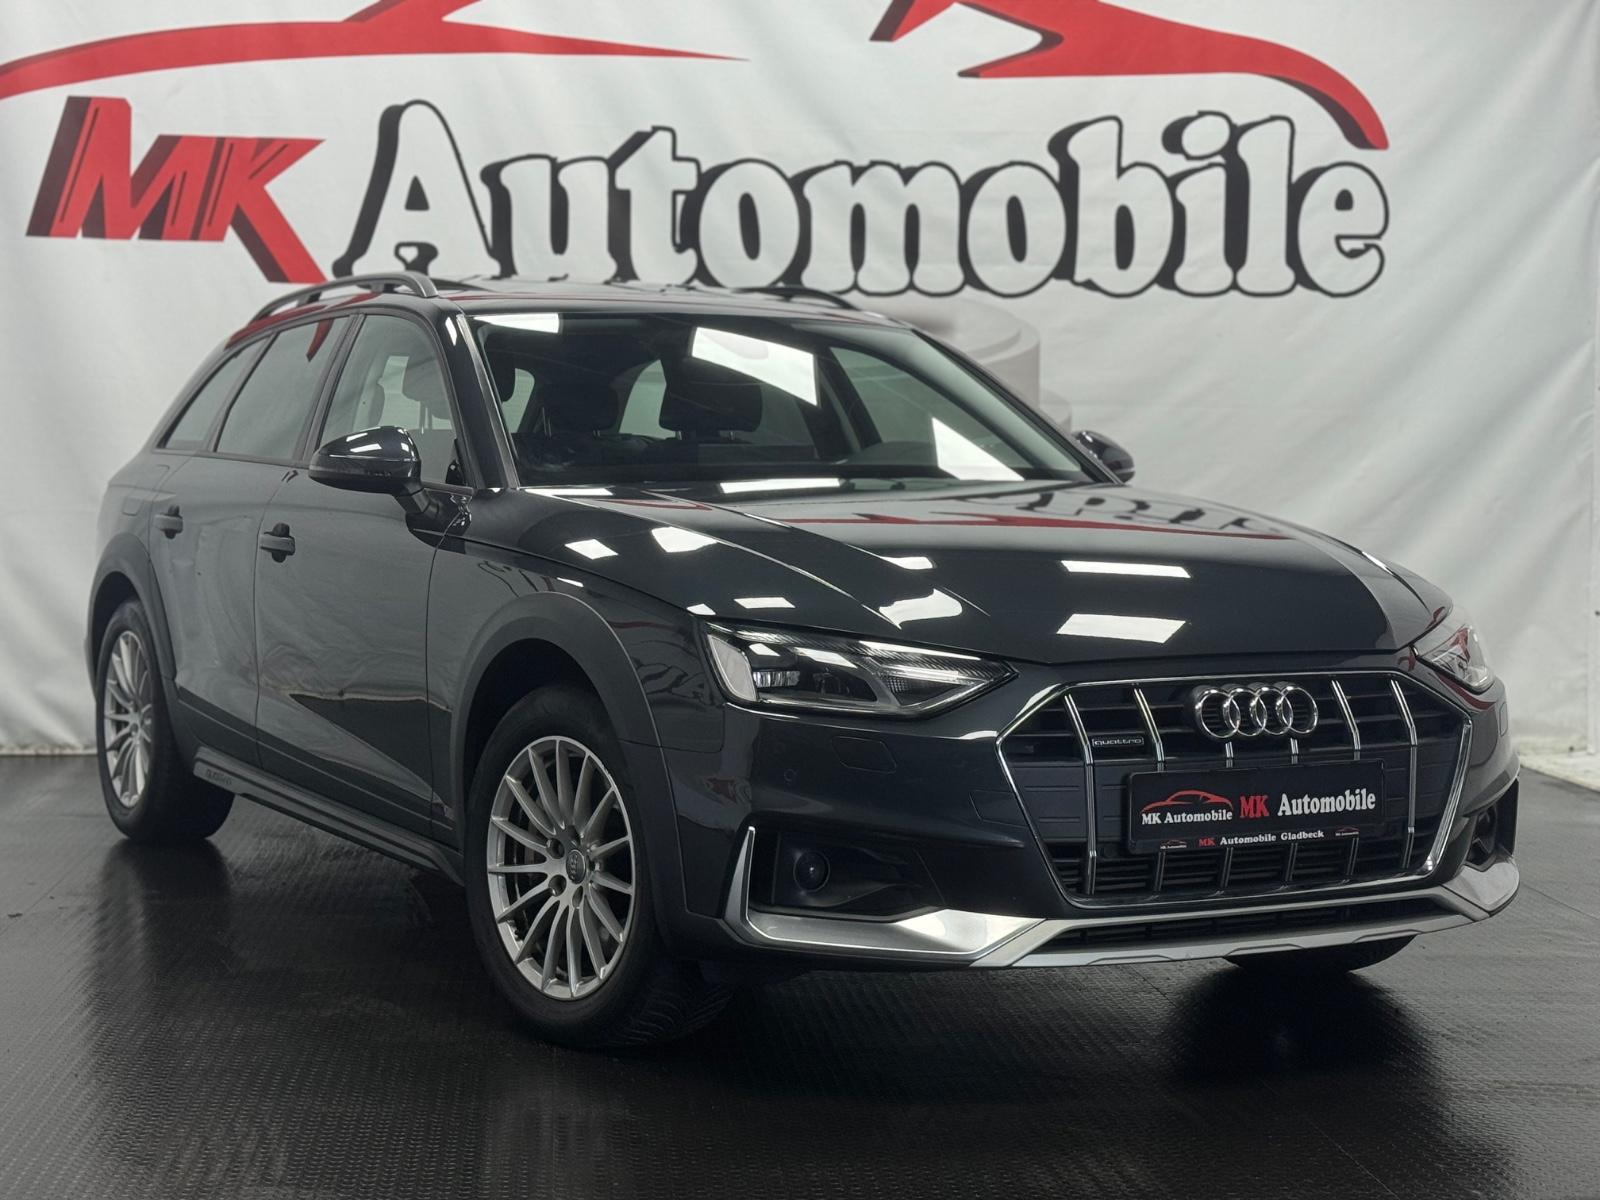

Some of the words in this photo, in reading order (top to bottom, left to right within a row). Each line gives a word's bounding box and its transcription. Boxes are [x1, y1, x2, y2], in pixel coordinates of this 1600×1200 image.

[26, 96, 325, 284] MK
[331, 99, 1390, 298] Automobile
[1094, 738, 1142, 746] quattro
[1240, 795, 1270, 819] MK
[1277, 788, 1377, 817] Automobile
[1142, 812, 1162, 825] MK
[1164, 809, 1233, 824] Automobile
[1199, 838, 1216, 847] MK
[1220, 833, 1277, 846] Automobile
[1280, 830, 1325, 841] Gladbeck
